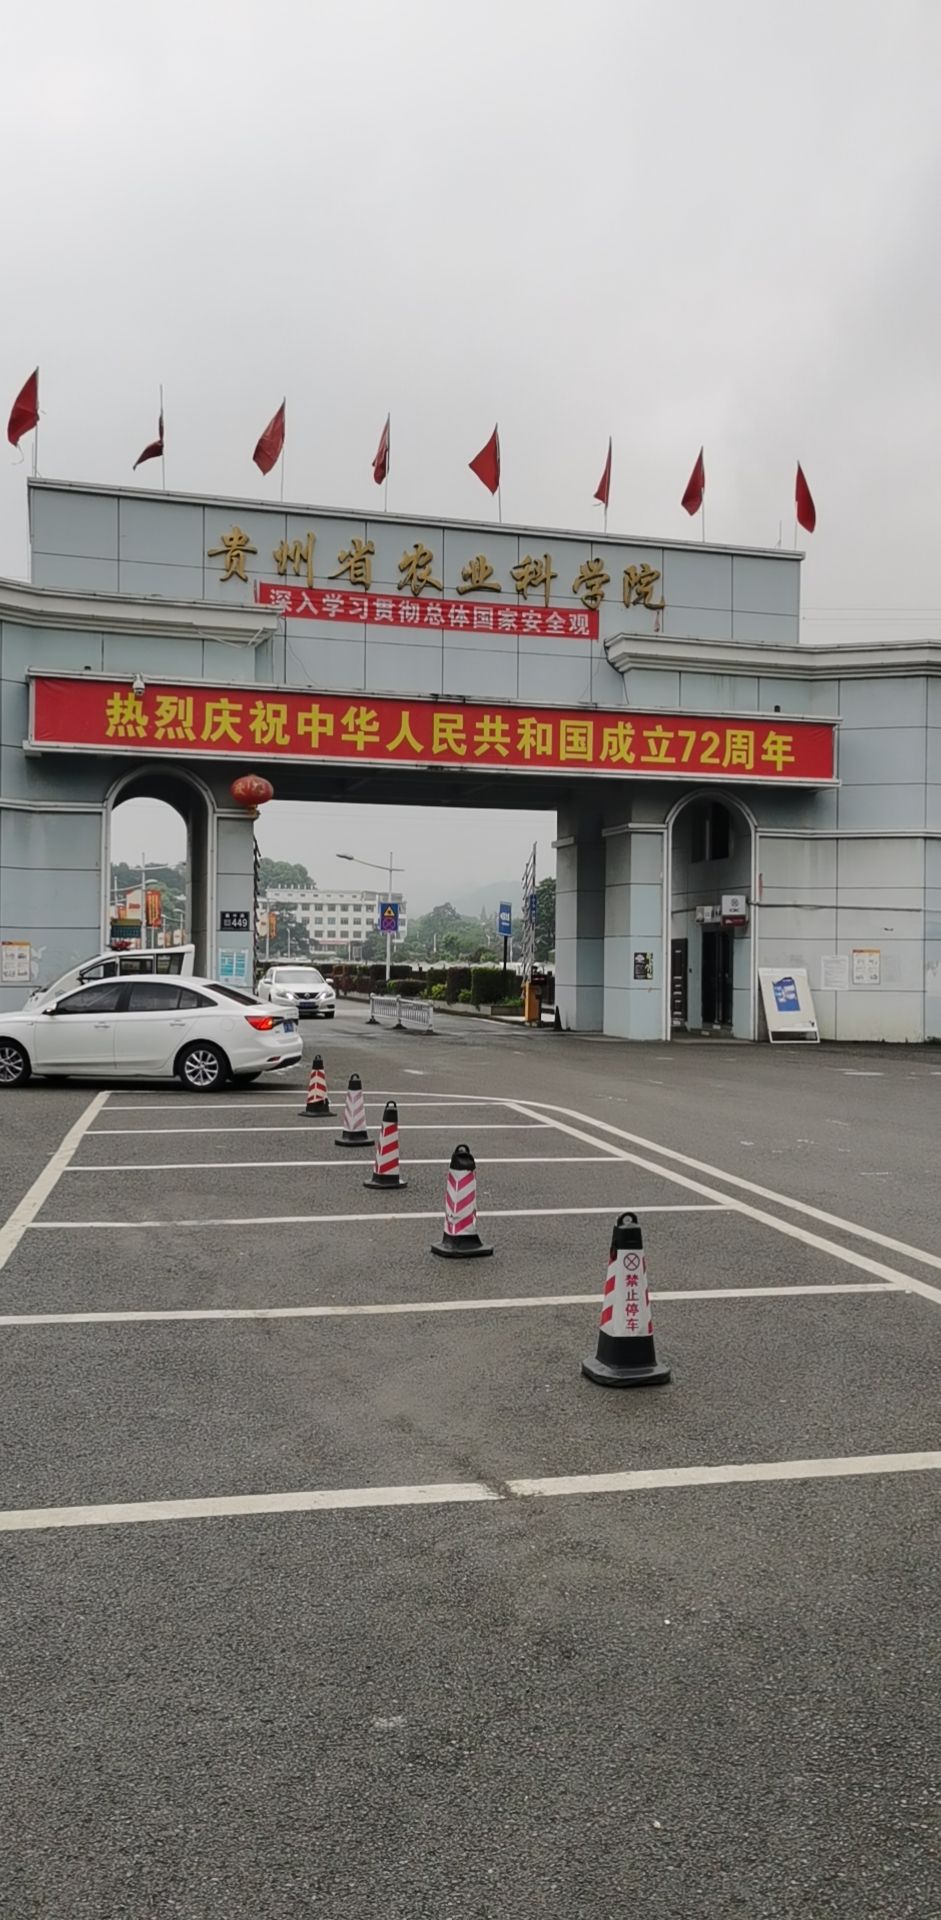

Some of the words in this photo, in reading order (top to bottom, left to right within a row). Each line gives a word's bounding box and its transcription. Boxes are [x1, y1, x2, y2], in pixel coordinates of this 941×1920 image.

[207, 526, 666, 611] 贵州省农业科学院
[269, 588, 590, 636] 深入学习贯彻总体国家安全观
[105, 691, 796, 771] 热烈庆祝中华人民共和国成立72周年
[625, 1274, 639, 1331] 禁止停车
